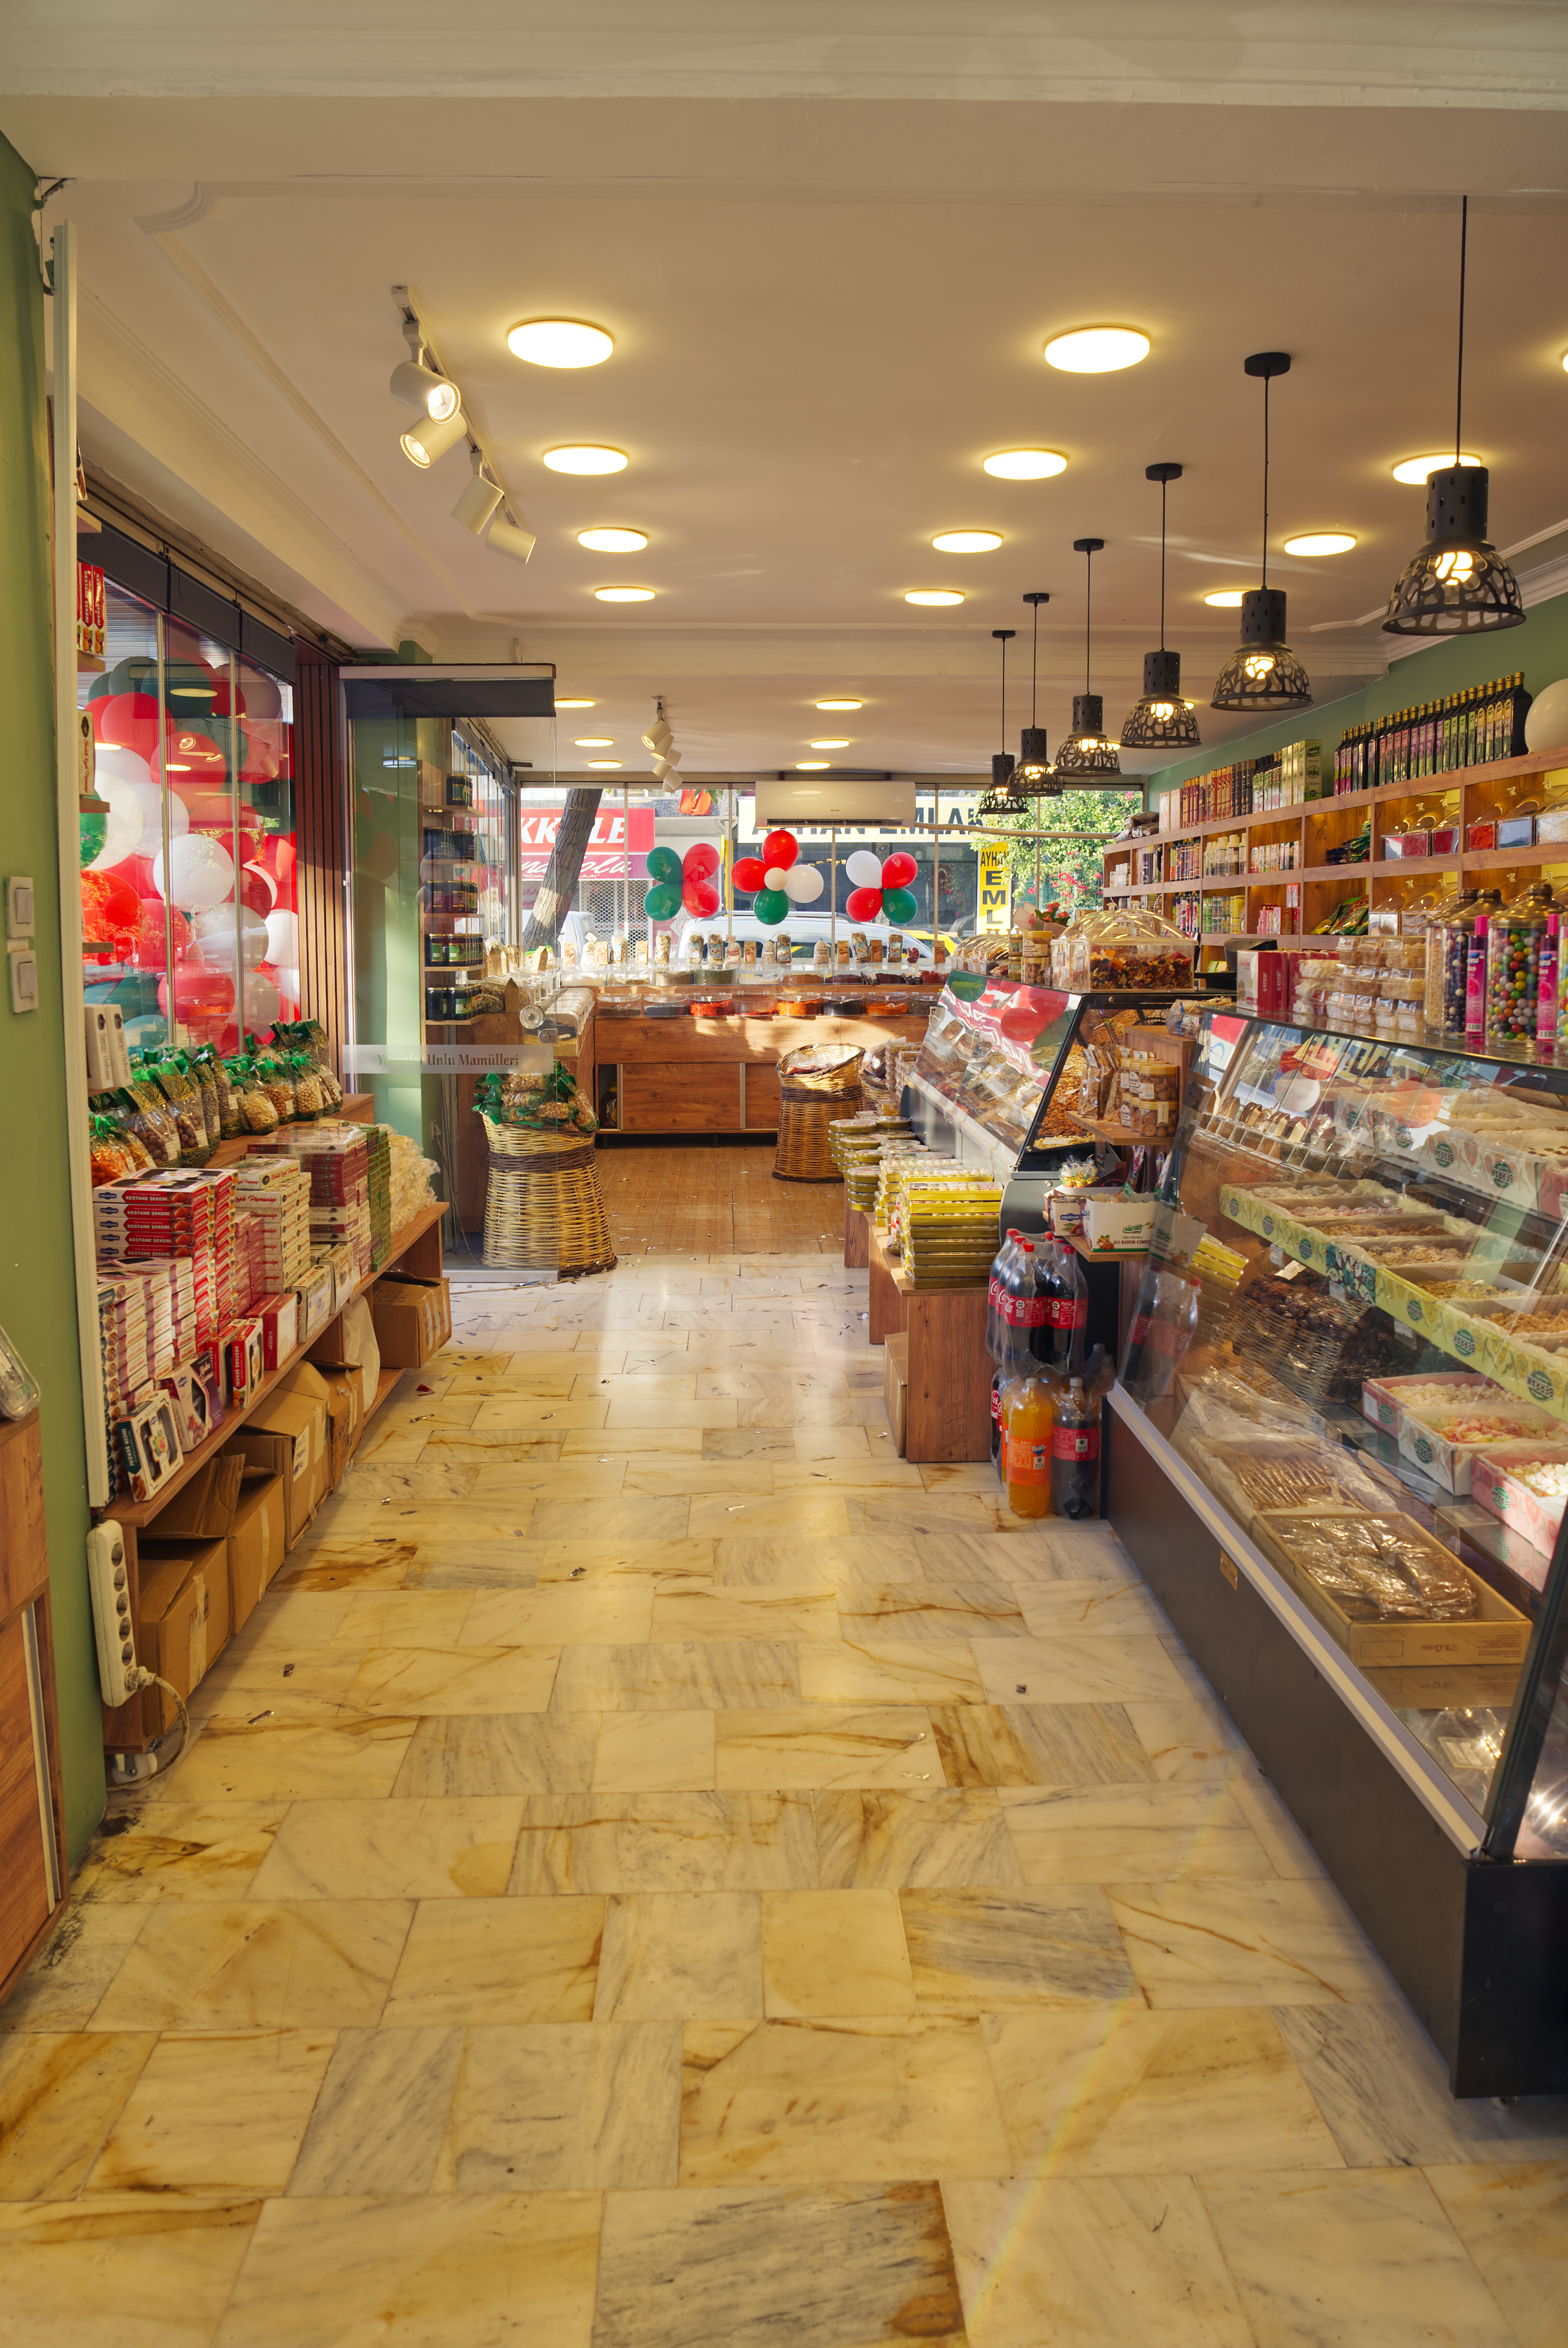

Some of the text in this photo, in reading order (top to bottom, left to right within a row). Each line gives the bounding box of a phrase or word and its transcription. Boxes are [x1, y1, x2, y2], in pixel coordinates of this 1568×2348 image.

[521, 817, 625, 844] KKLE
[427, 1053, 455, 1065] Unlu
[459, 1053, 519, 1065] Mamülleri
[1527, 1374, 1554, 1400] BERRAK
[125, 1446, 135, 1466] ŞEKERİ
[1032, 1444, 1047, 1452] FANTA
